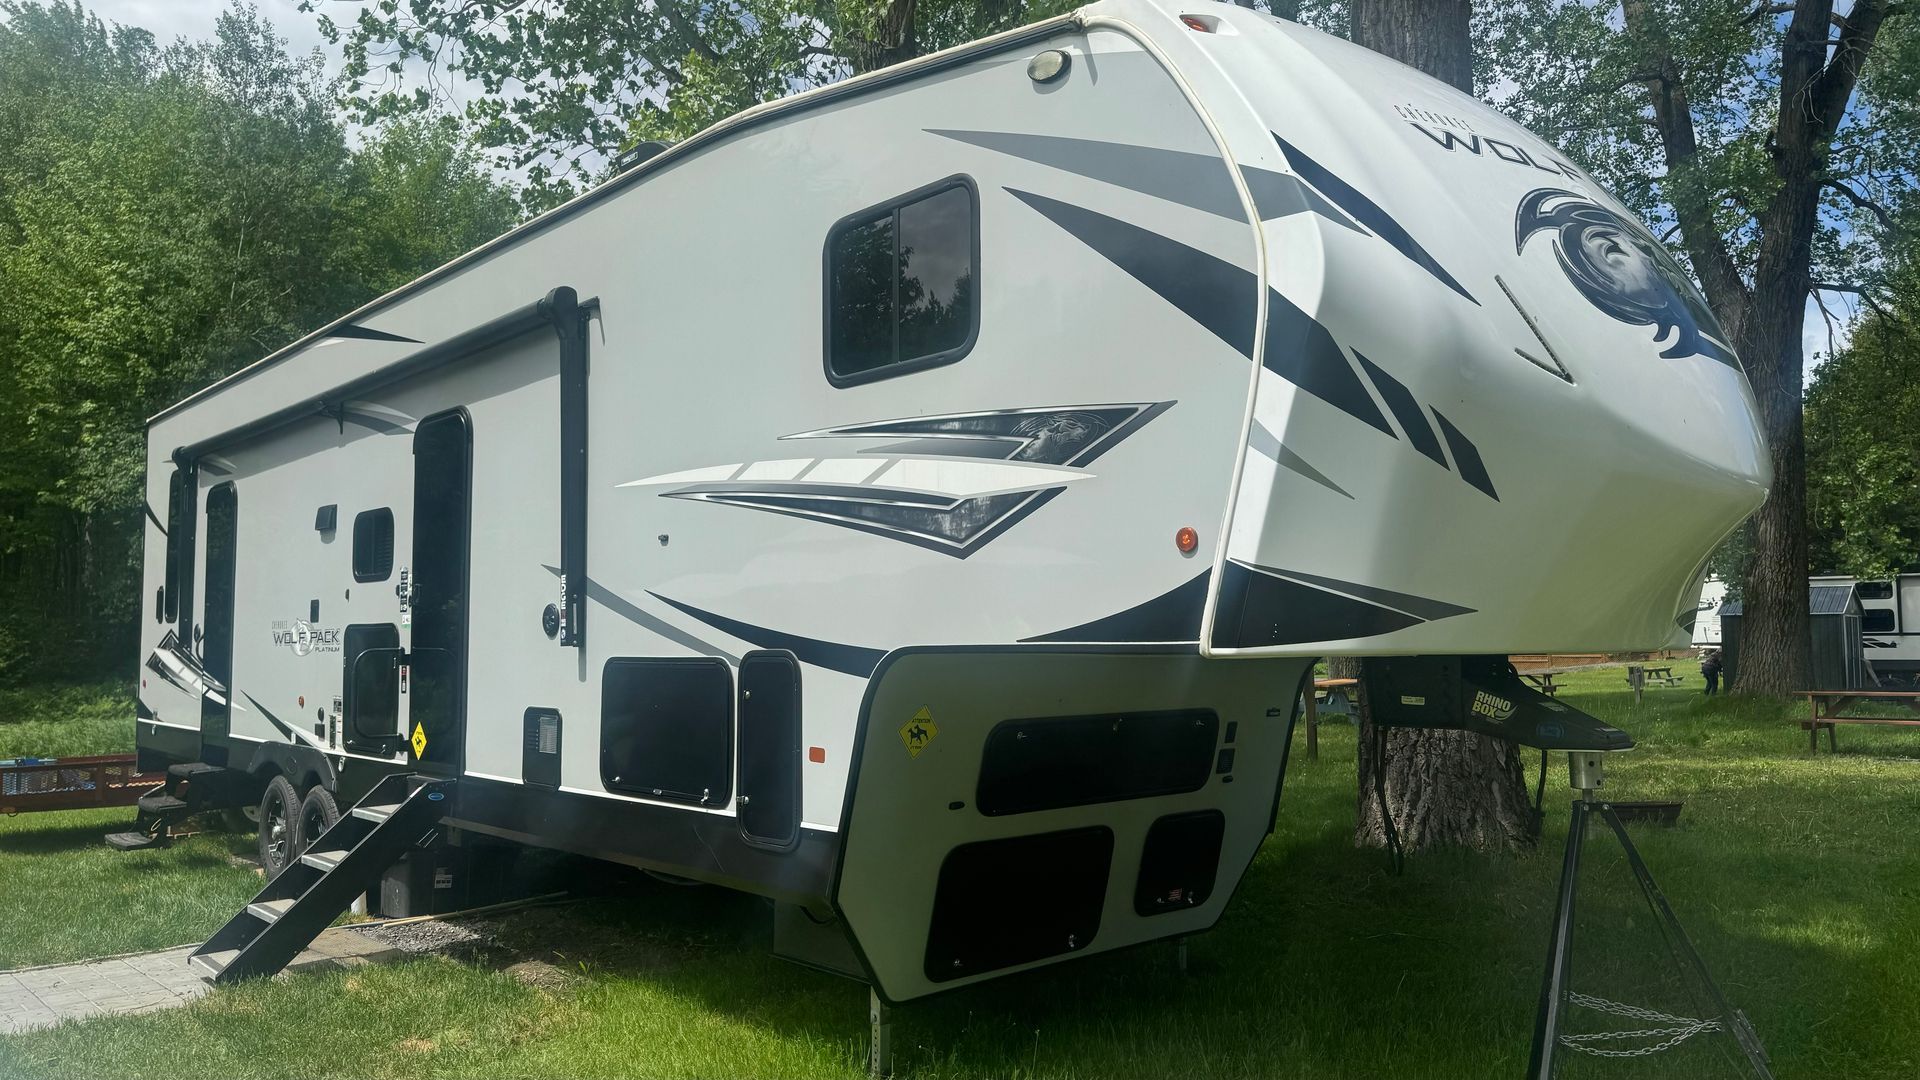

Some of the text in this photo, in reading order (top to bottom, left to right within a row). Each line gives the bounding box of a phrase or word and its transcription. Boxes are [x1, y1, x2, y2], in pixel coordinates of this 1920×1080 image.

[273, 630, 339, 645] WOLF PACK
[1472, 700, 1498, 718] BOX
[1475, 690, 1511, 712] RHINO
